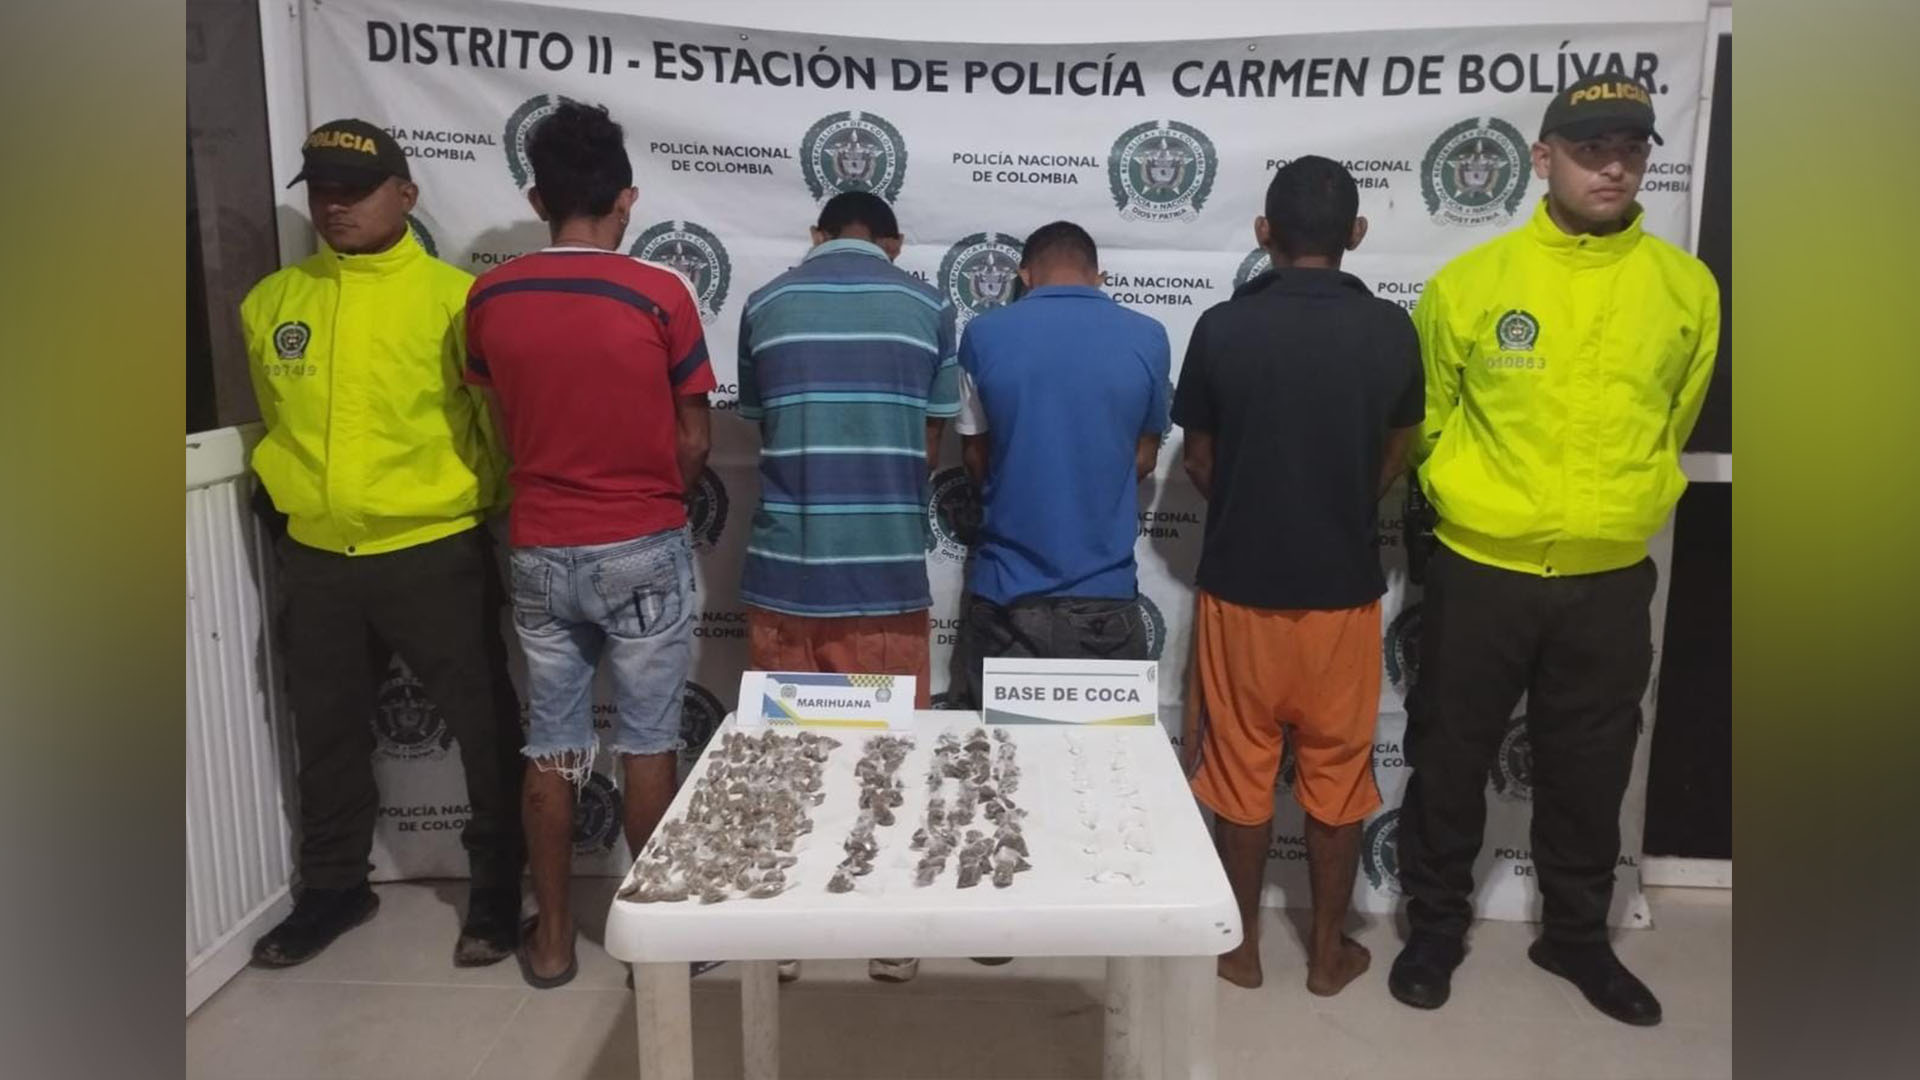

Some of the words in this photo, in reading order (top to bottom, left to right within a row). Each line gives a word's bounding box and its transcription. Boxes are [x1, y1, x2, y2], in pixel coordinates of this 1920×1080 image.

[367, 20, 573, 71] DISTRITO
[628, 60, 640, 68] -
[653, 40, 877, 90] ESTACIÓN
[891, 58, 948, 93] DE
[965, 53, 1146, 97] POLICÍA
[1172, 58, 1369, 97] CARMEN
[1382, 54, 1445, 96] DE
[1458, 40, 1669, 95] BOLÍVAR.
[1570, 82, 1652, 106] POLICIA
[412, 130, 497, 146] NACIONAL
[403, 145, 476, 161] OLOMBIA
[650, 142, 709, 156] POLICÍA
[713, 145, 792, 159] NACIONAL
[671, 159, 691, 171] DE
[694, 161, 774, 175] COLOMBIA
[952, 151, 1013, 166] POLICÍA
[1018, 154, 1100, 168] NACIONAL
[1339, 159, 1413, 171] ACIONAL
[972, 170, 993, 182] DE
[996, 171, 1078, 184] COLOMBIA
[1133, 275, 1215, 290] NACIONAL
[1377, 282, 1424, 293] POLIC
[1112, 292, 1193, 306] COLOMBIA
[1139, 511, 1200, 524] CIONAL
[994, 686, 1046, 701] BASE
[1052, 687, 1078, 701] DE
[1084, 687, 1141, 702] COCA
[796, 698, 872, 709] MARIHUANA
[398, 821, 418, 832] DE
[421, 818, 465, 831] COLO
